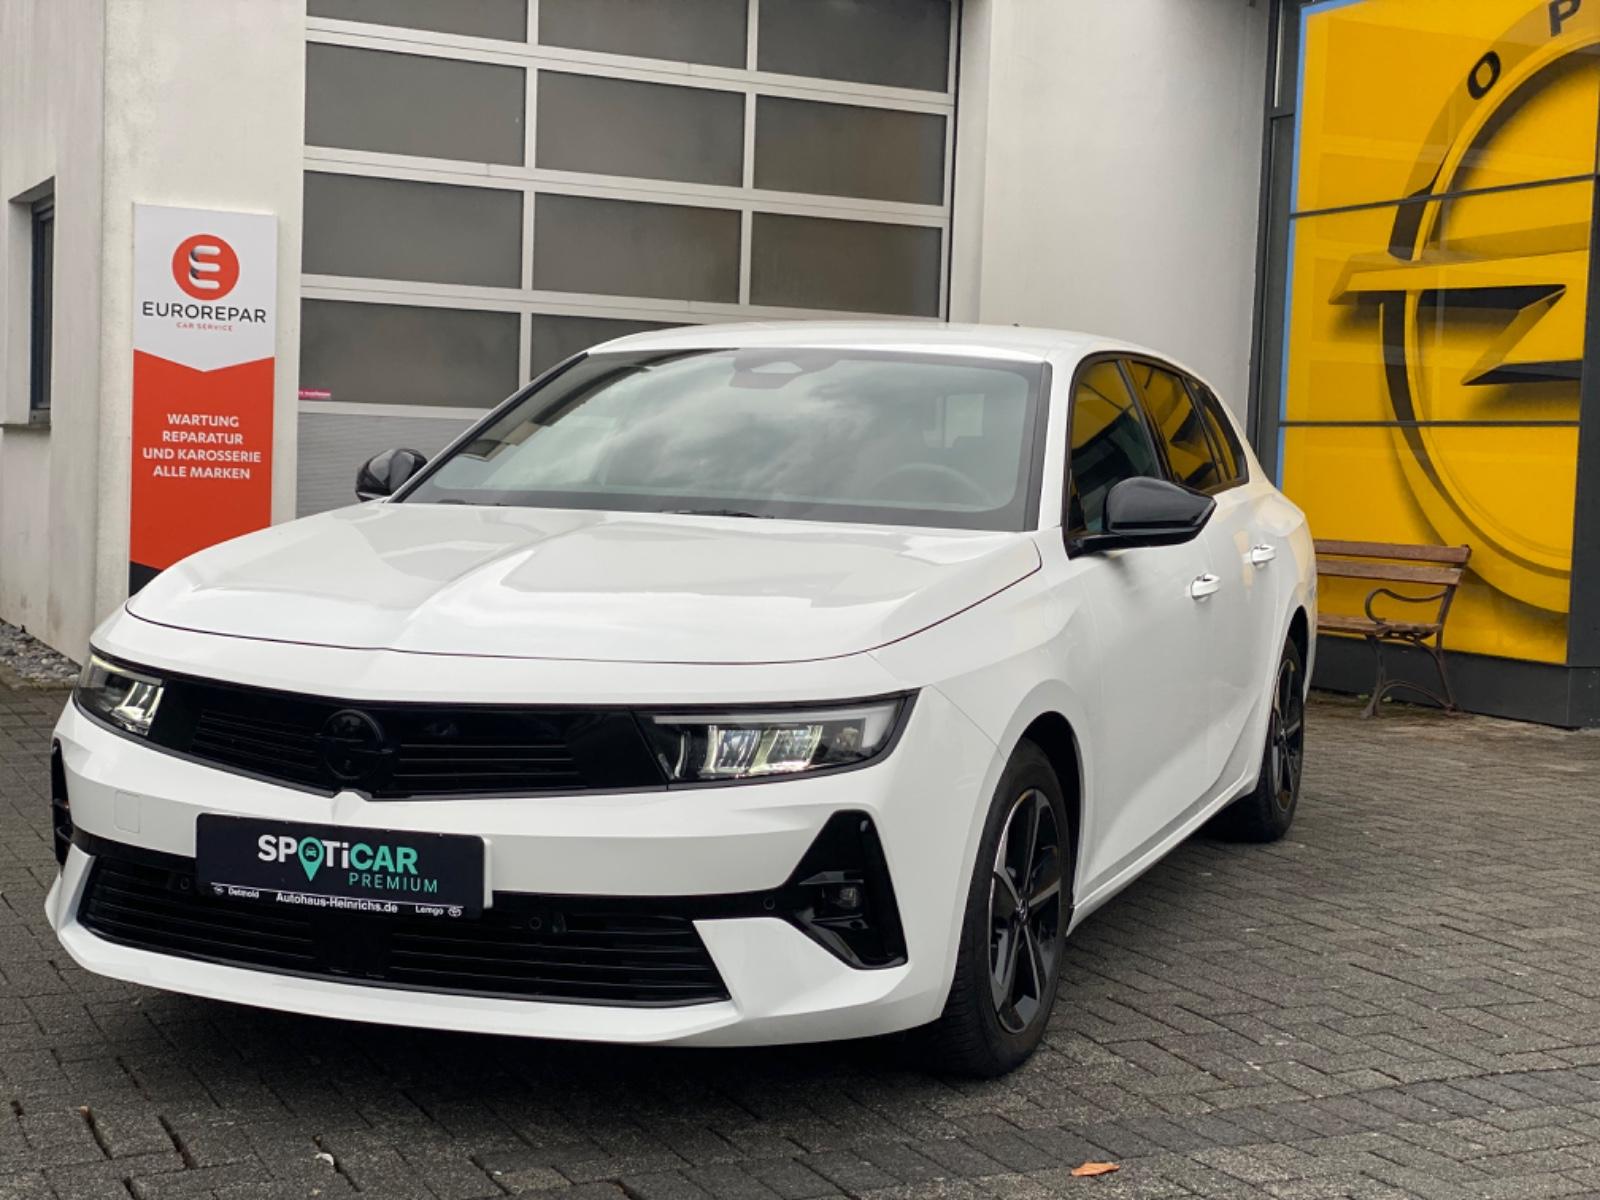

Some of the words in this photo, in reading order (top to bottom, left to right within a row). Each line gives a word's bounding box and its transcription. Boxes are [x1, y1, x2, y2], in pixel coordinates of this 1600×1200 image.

[142, 301, 267, 323] EUROREPAR
[197, 322, 233, 332] SERVICE
[167, 413, 240, 428] WARTUNG
[162, 430, 244, 445] REPARATUR
[142, 447, 175, 460] UND
[177, 448, 262, 463] KAROSSERIE
[153, 465, 187, 478] ALLE
[190, 466, 251, 480] MARKEN
[348, 872, 438, 893] PREMIUM
[228, 886, 260, 899] Detmold
[276, 892, 398, 913] Autohaus-Heinrichs.de
[415, 904, 444, 916] Lemgo
